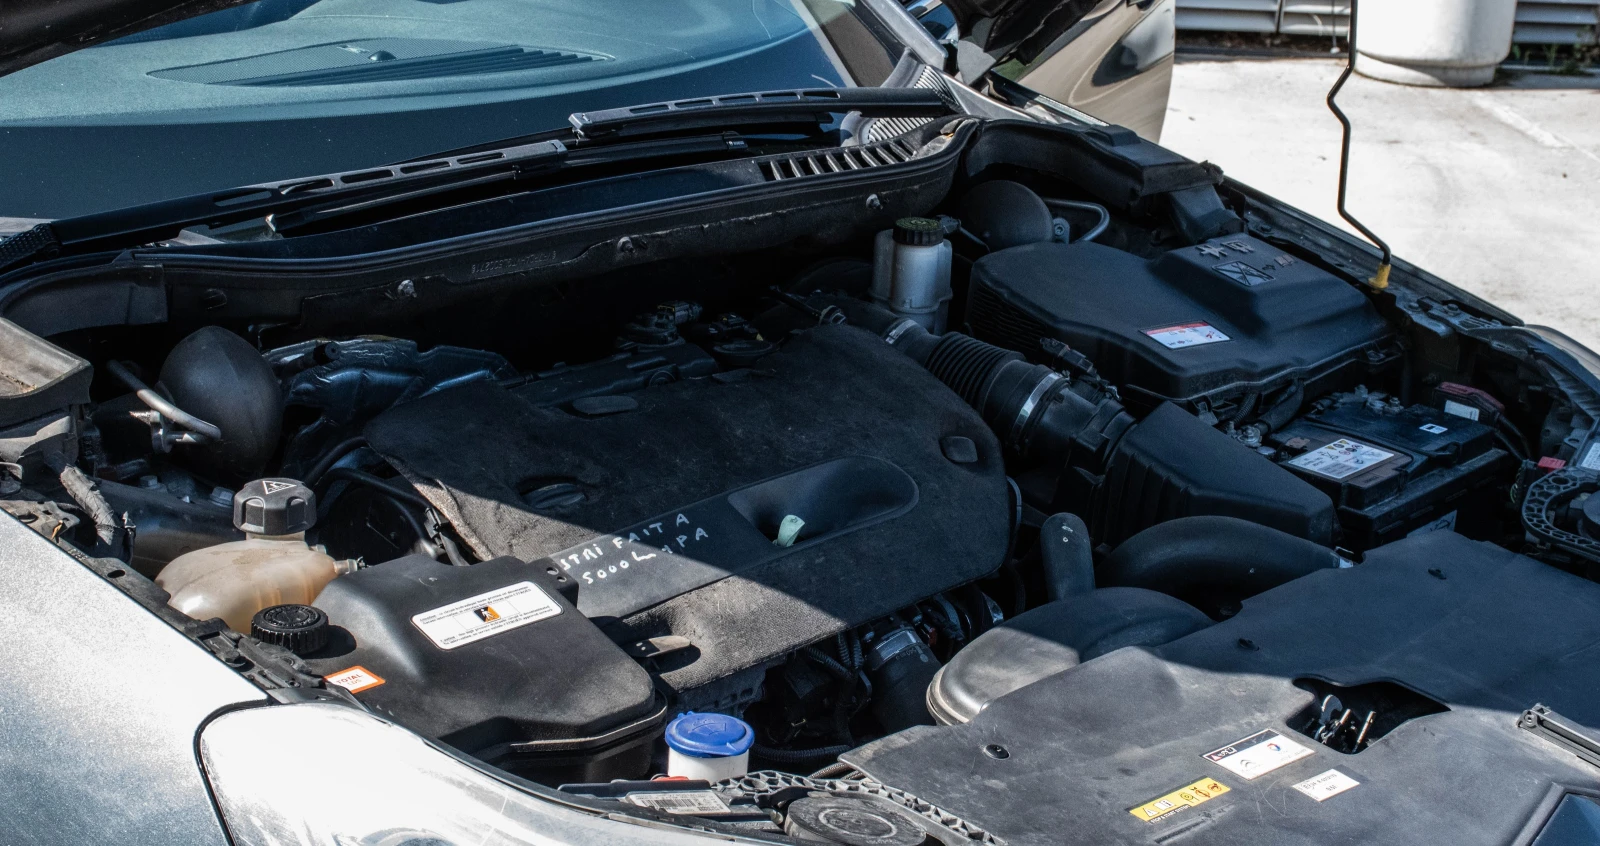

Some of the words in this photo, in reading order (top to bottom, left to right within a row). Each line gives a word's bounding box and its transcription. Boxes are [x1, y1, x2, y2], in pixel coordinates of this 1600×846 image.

[612, 522, 663, 549] FAIT
[676, 513, 690, 527] A
[336, 673, 364, 685] TOTAL
